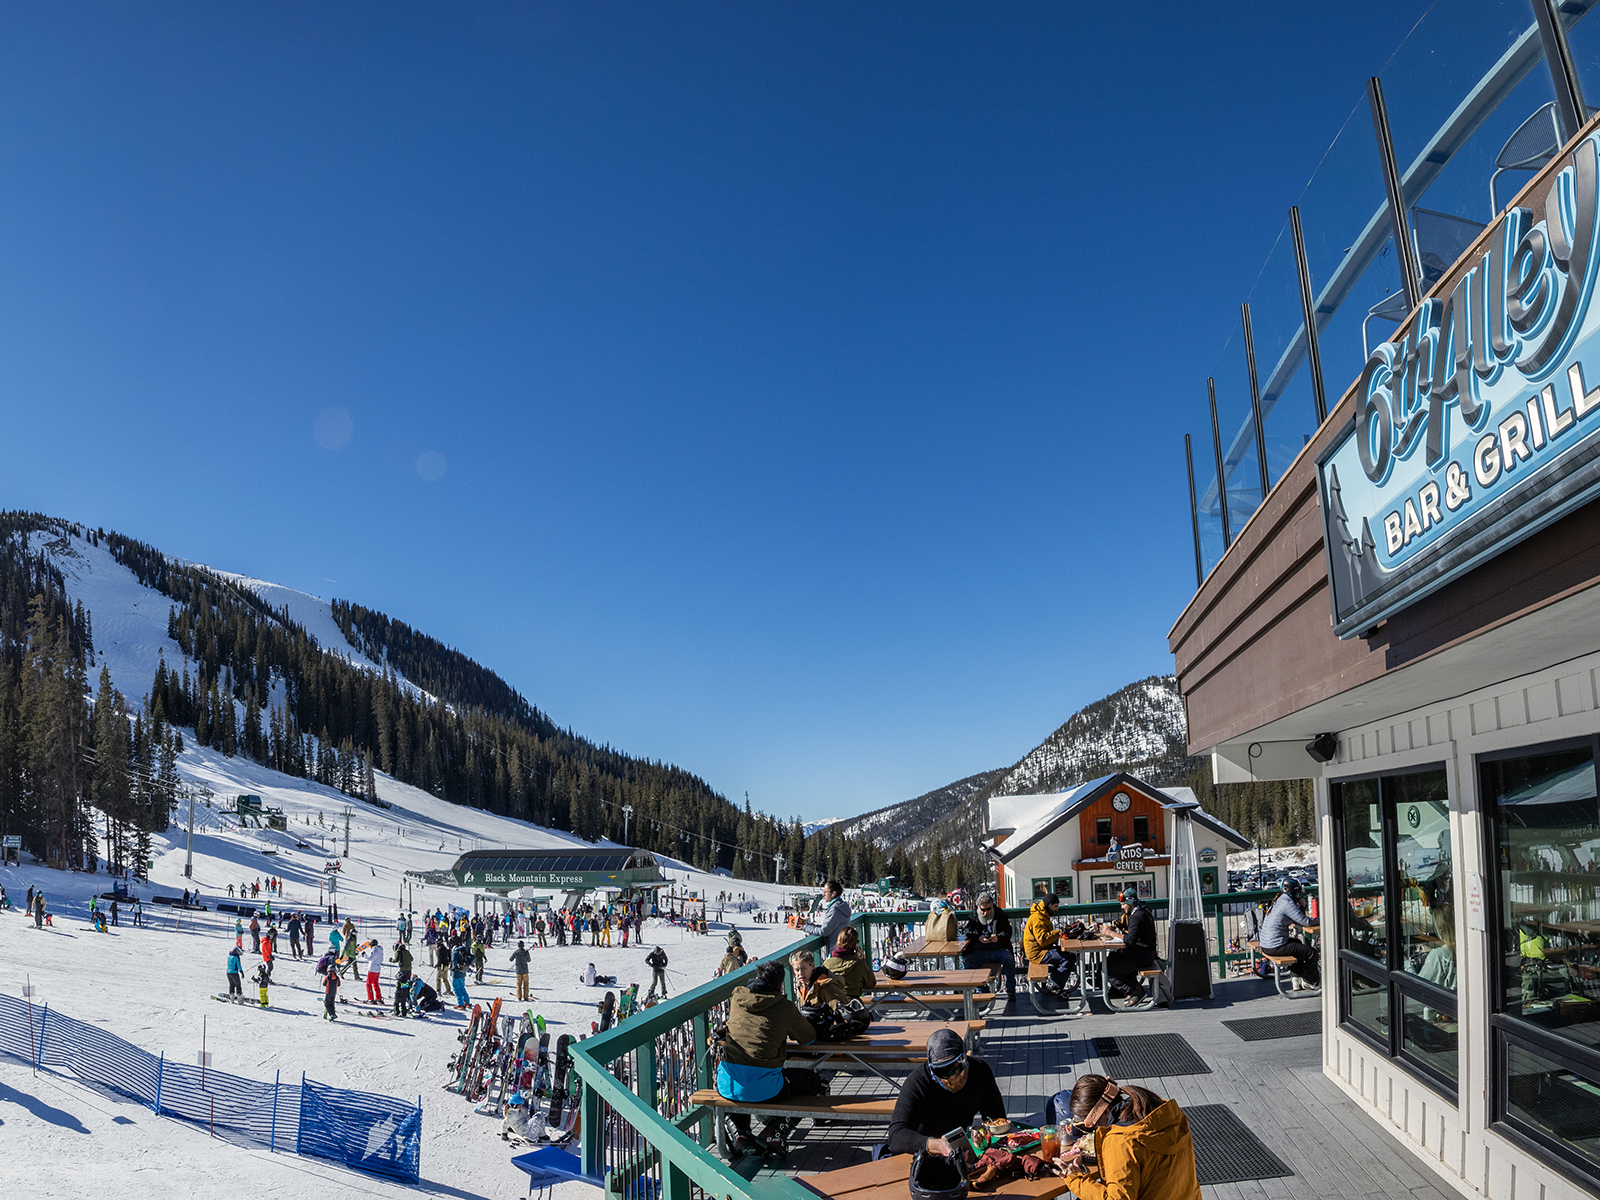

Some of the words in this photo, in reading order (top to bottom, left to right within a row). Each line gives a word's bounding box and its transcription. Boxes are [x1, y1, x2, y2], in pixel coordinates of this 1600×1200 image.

[1383, 478, 1444, 558] BAR
[1445, 459, 1473, 513] &
[1472, 359, 1600, 490] GRILL
[1120, 847, 1142, 860] KIDS
[1116, 861, 1144, 871] CENTER
[484, 873, 506, 883] Black
[508, 873, 547, 883] Mountain
[549, 873, 583, 885] Express
